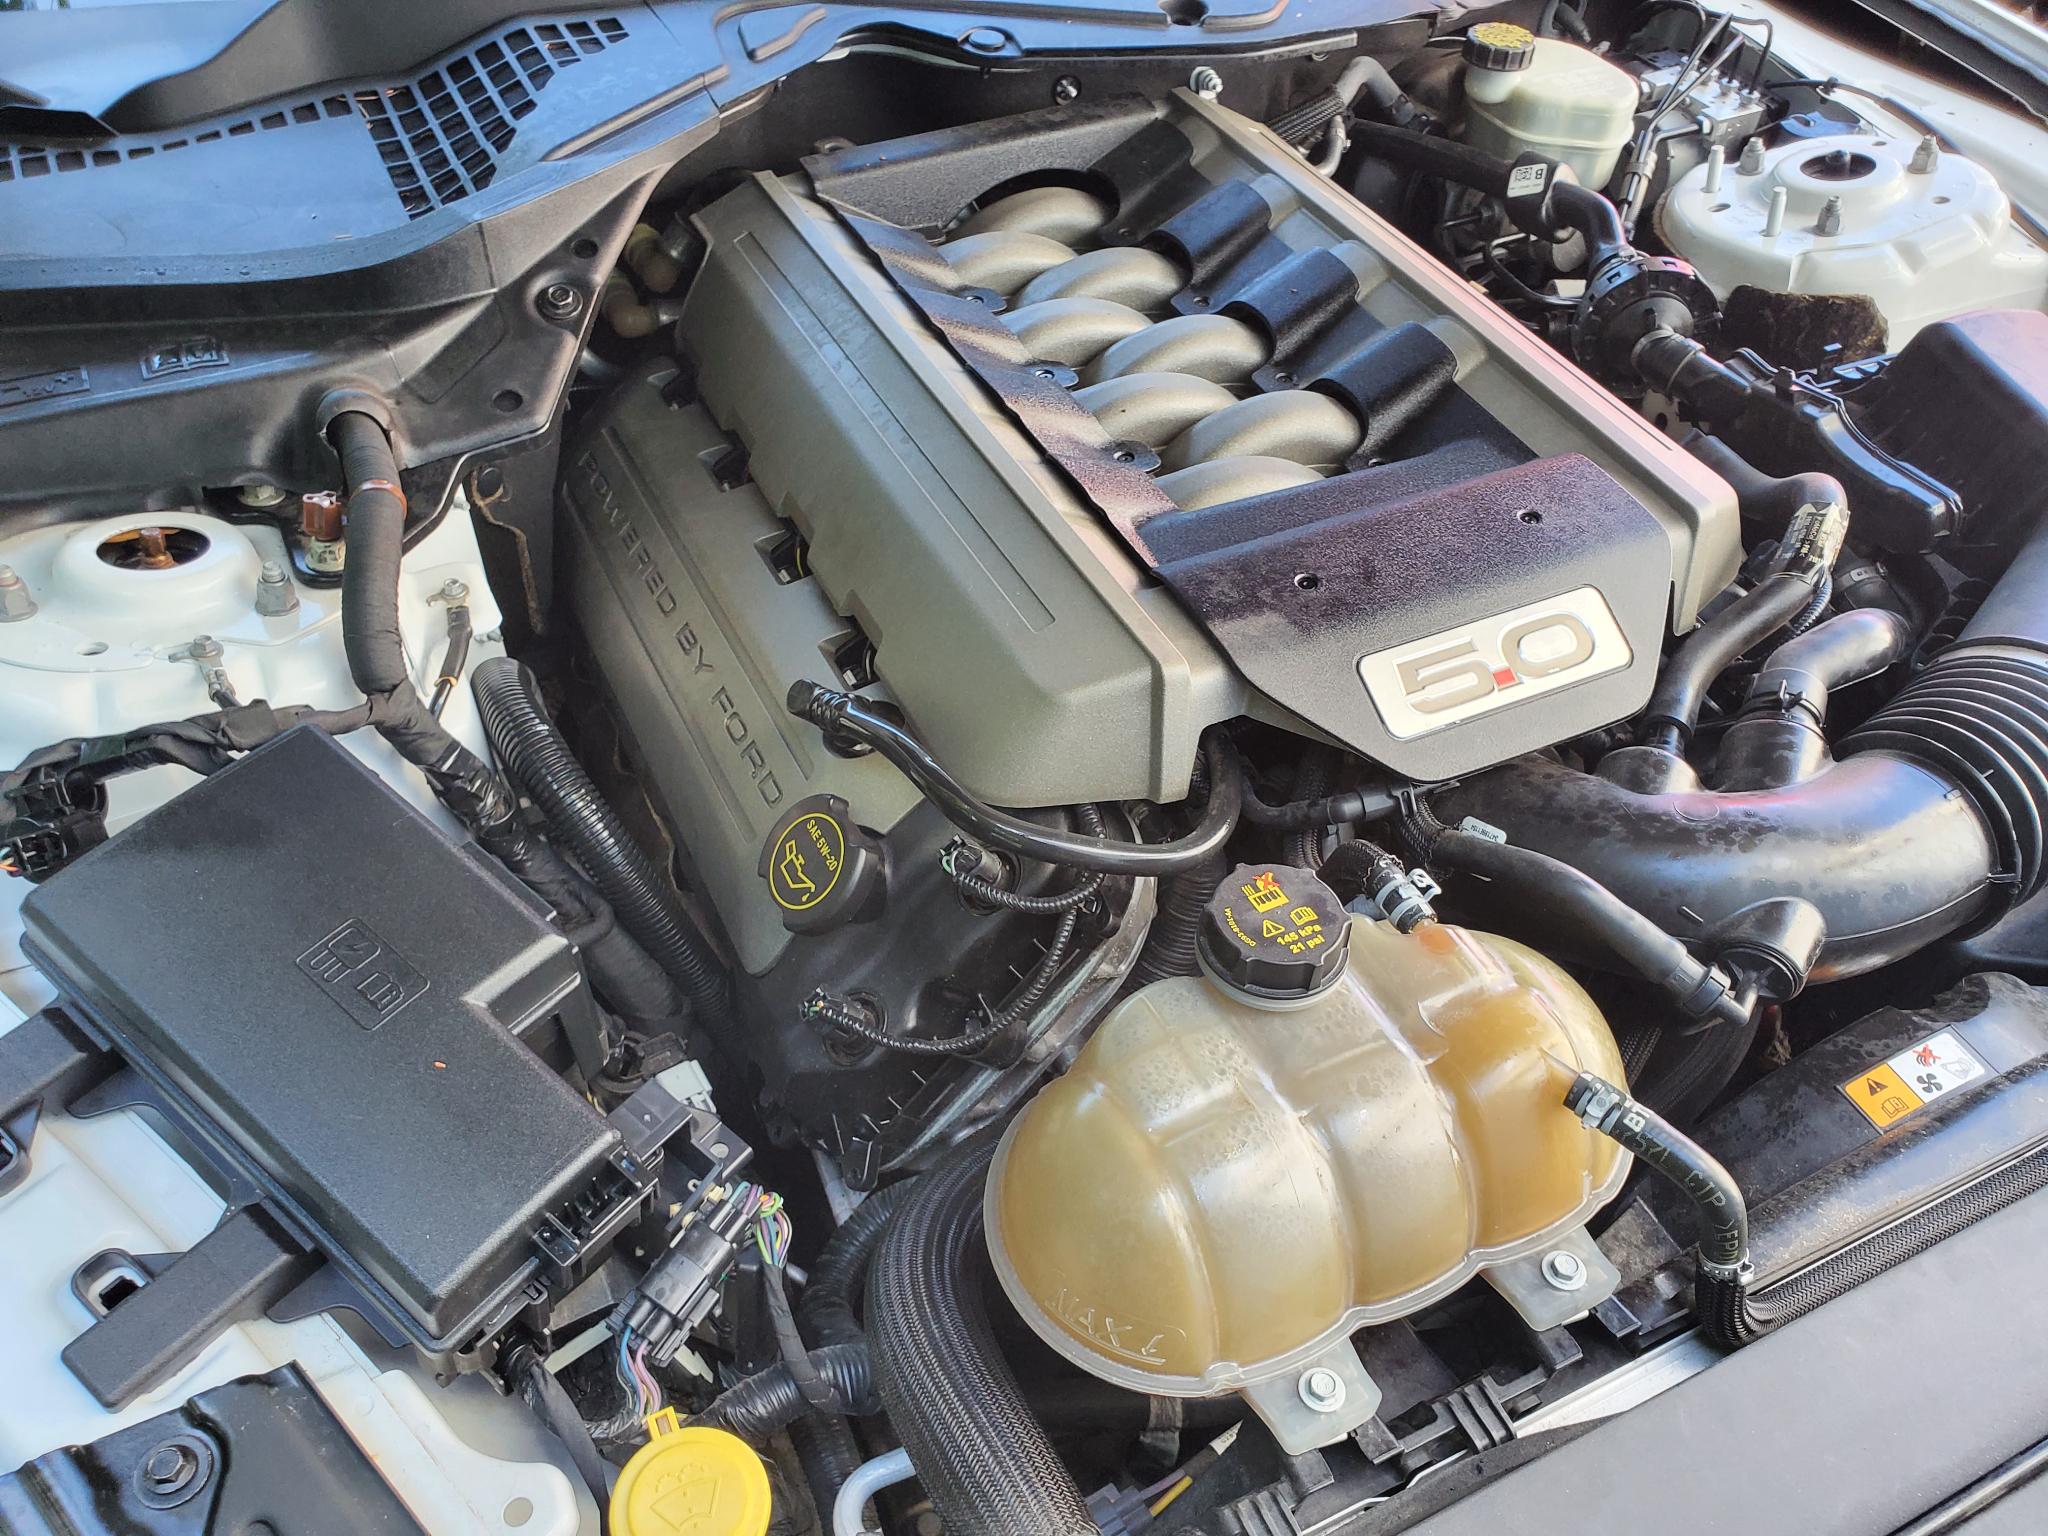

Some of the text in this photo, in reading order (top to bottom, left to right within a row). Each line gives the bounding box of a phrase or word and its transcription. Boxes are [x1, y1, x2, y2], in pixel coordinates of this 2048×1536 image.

[576, 450, 785, 808] POWERED BY FORD
[1395, 613, 1596, 715] 5.0
[807, 820, 838, 871] SAE 5W-20
[1277, 924, 1322, 946] 145 kPa
[1289, 934, 1325, 954] 21 psi
